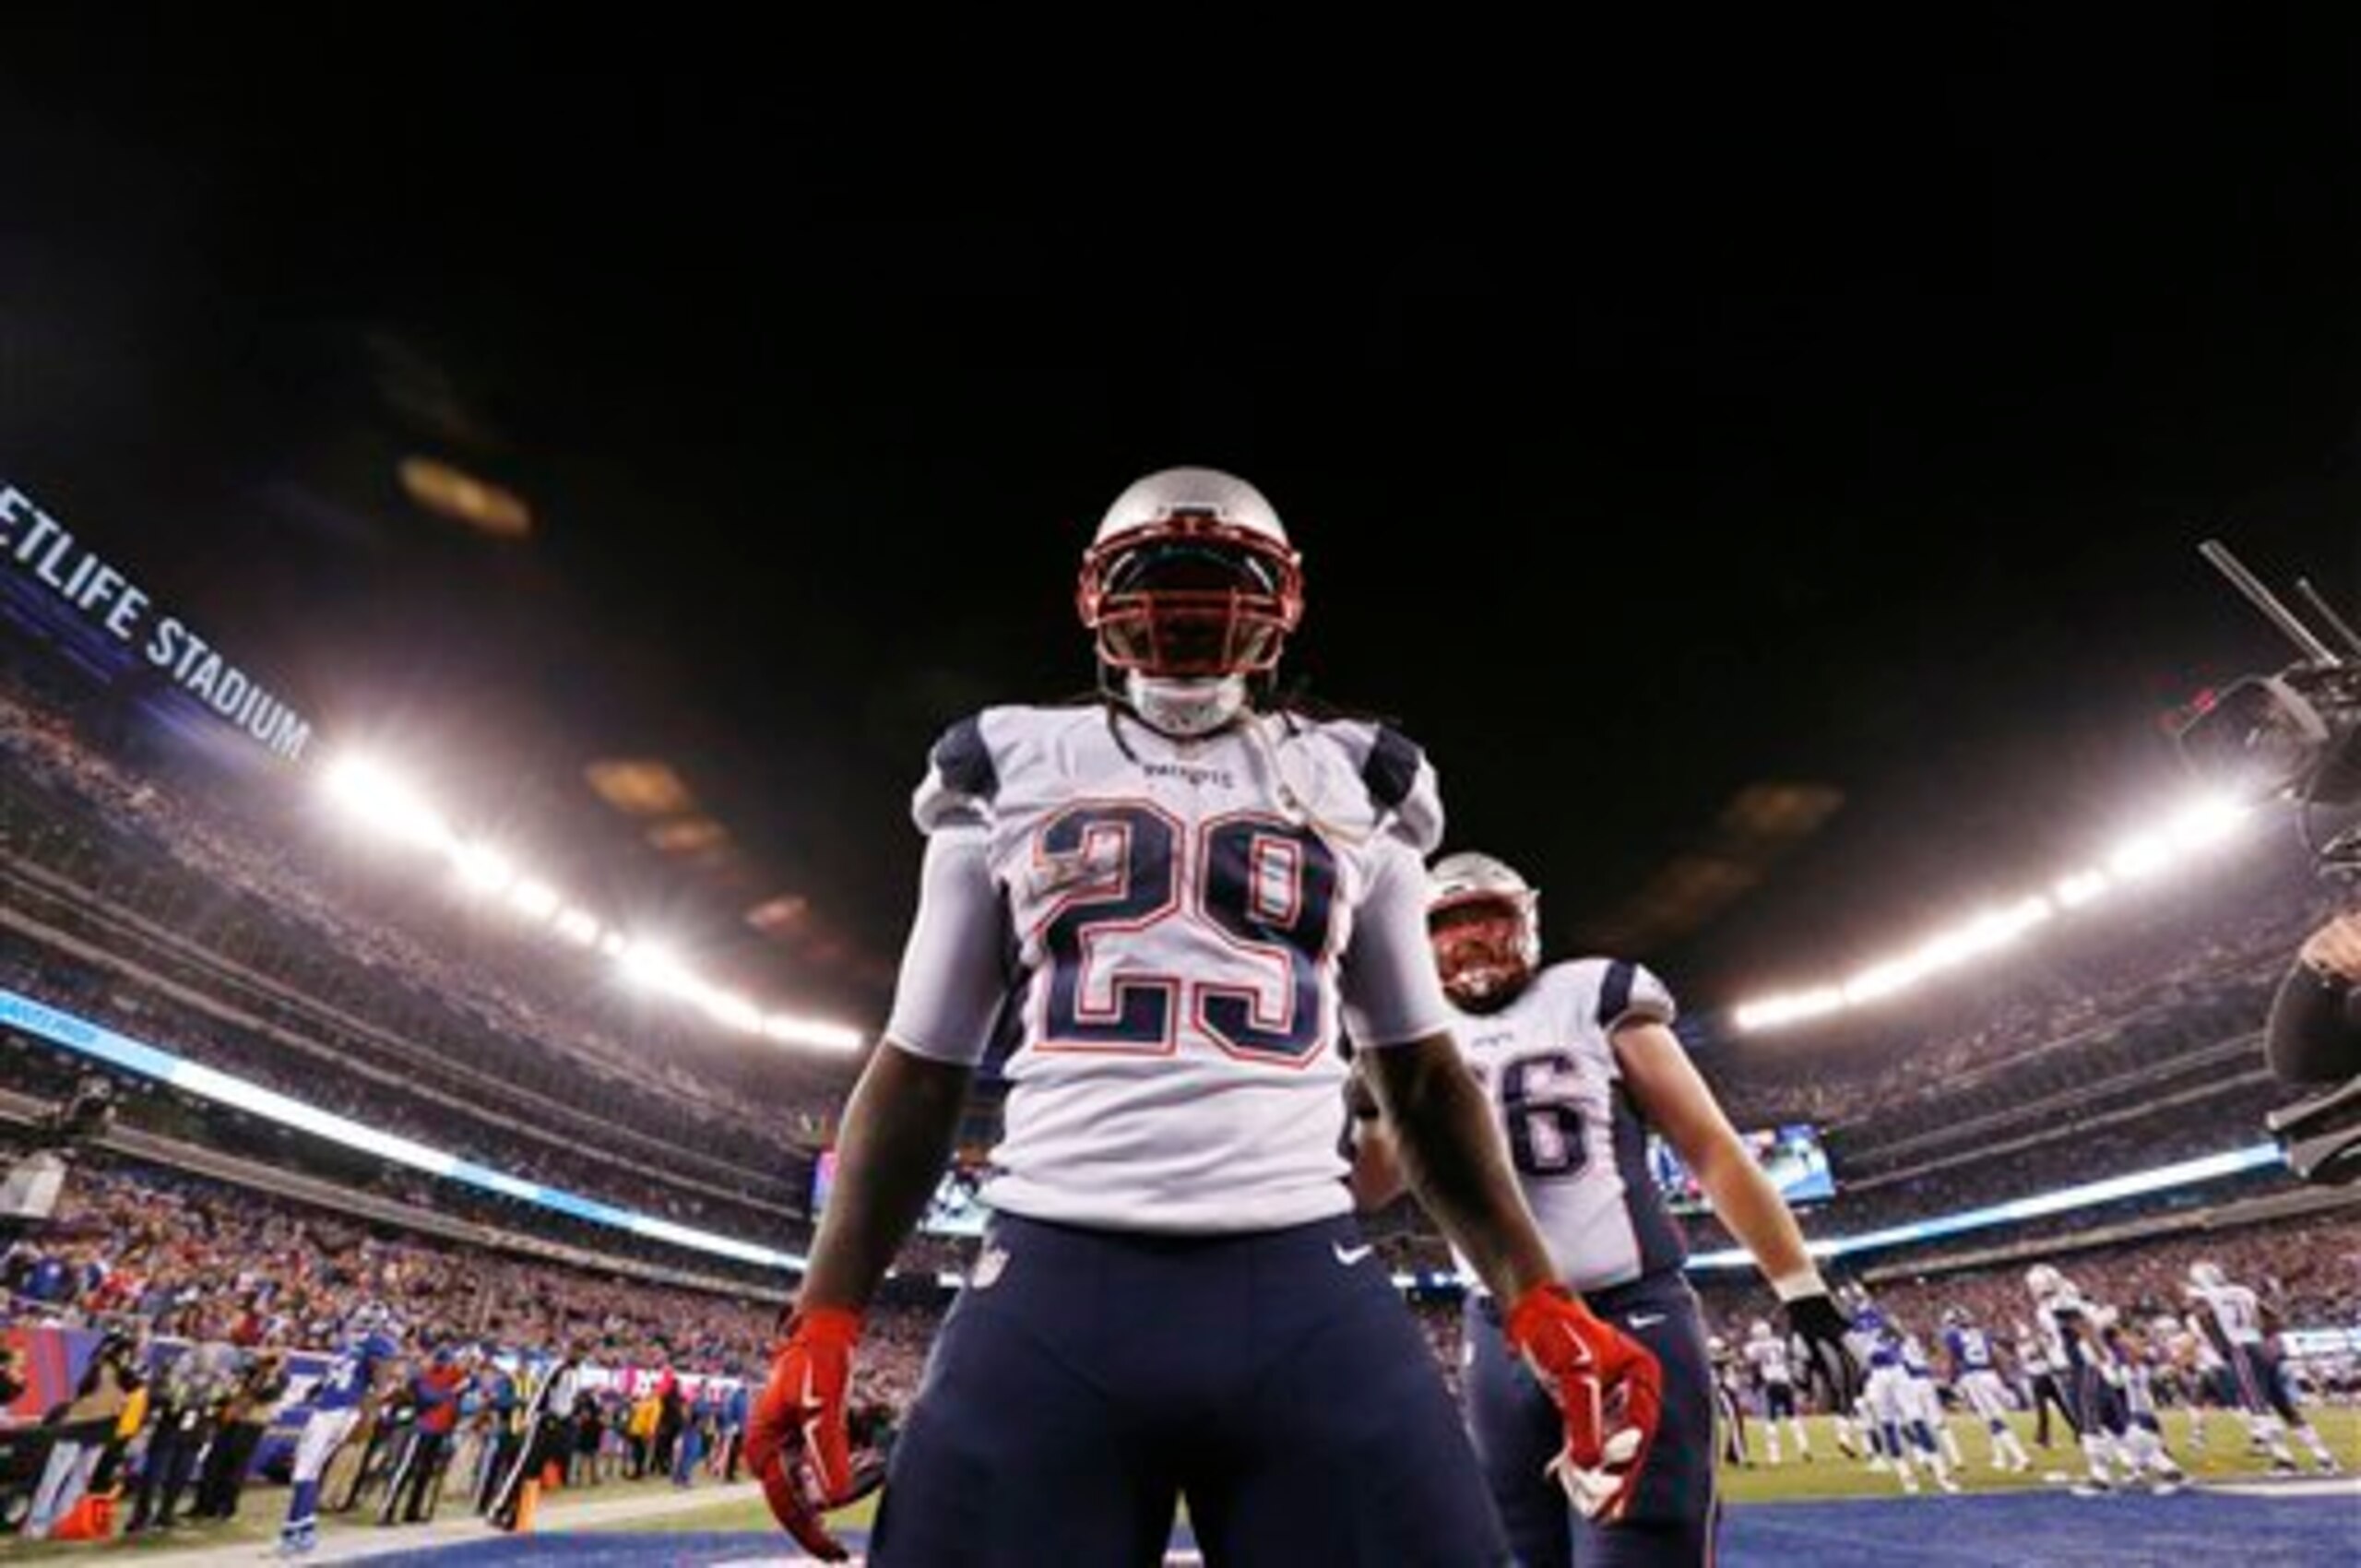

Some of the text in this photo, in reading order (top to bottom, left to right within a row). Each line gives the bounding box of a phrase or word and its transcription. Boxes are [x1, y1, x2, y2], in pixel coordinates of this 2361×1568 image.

[147, 617, 311, 760] STADIUM
[1031, 796, 1337, 1070] 29
[1474, 1046, 1590, 1182] 6
